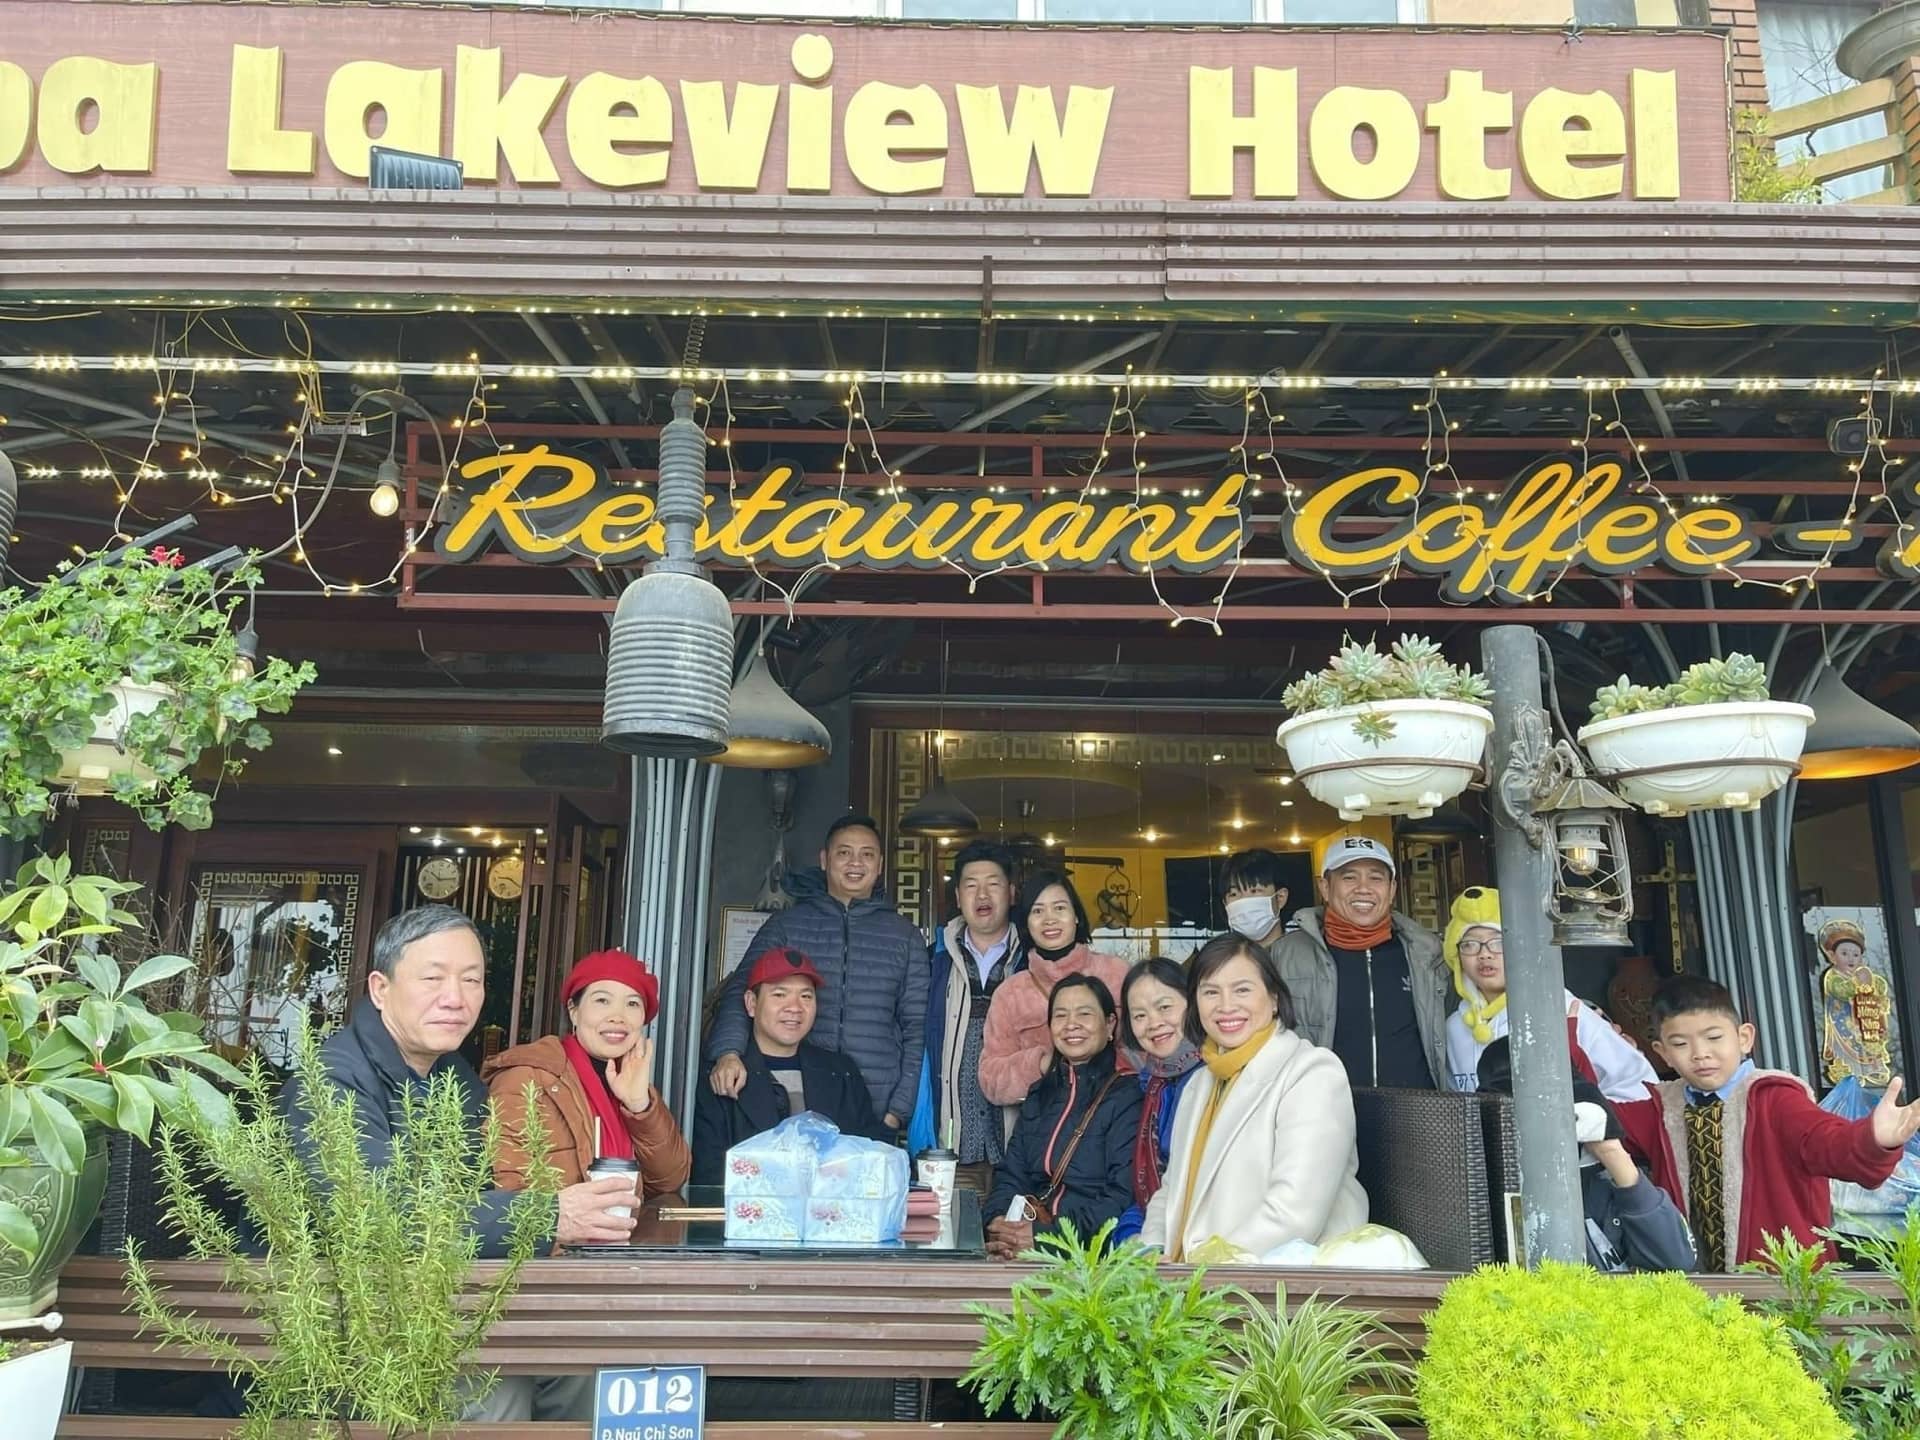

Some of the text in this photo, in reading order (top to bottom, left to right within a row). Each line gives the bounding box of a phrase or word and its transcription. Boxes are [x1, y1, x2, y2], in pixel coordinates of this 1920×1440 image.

[228, 33, 1115, 198] Lakeview
[1189, 66, 1681, 201] Hotel
[1292, 462, 1753, 596] Coffee
[607, 1375, 694, 1416] 012
